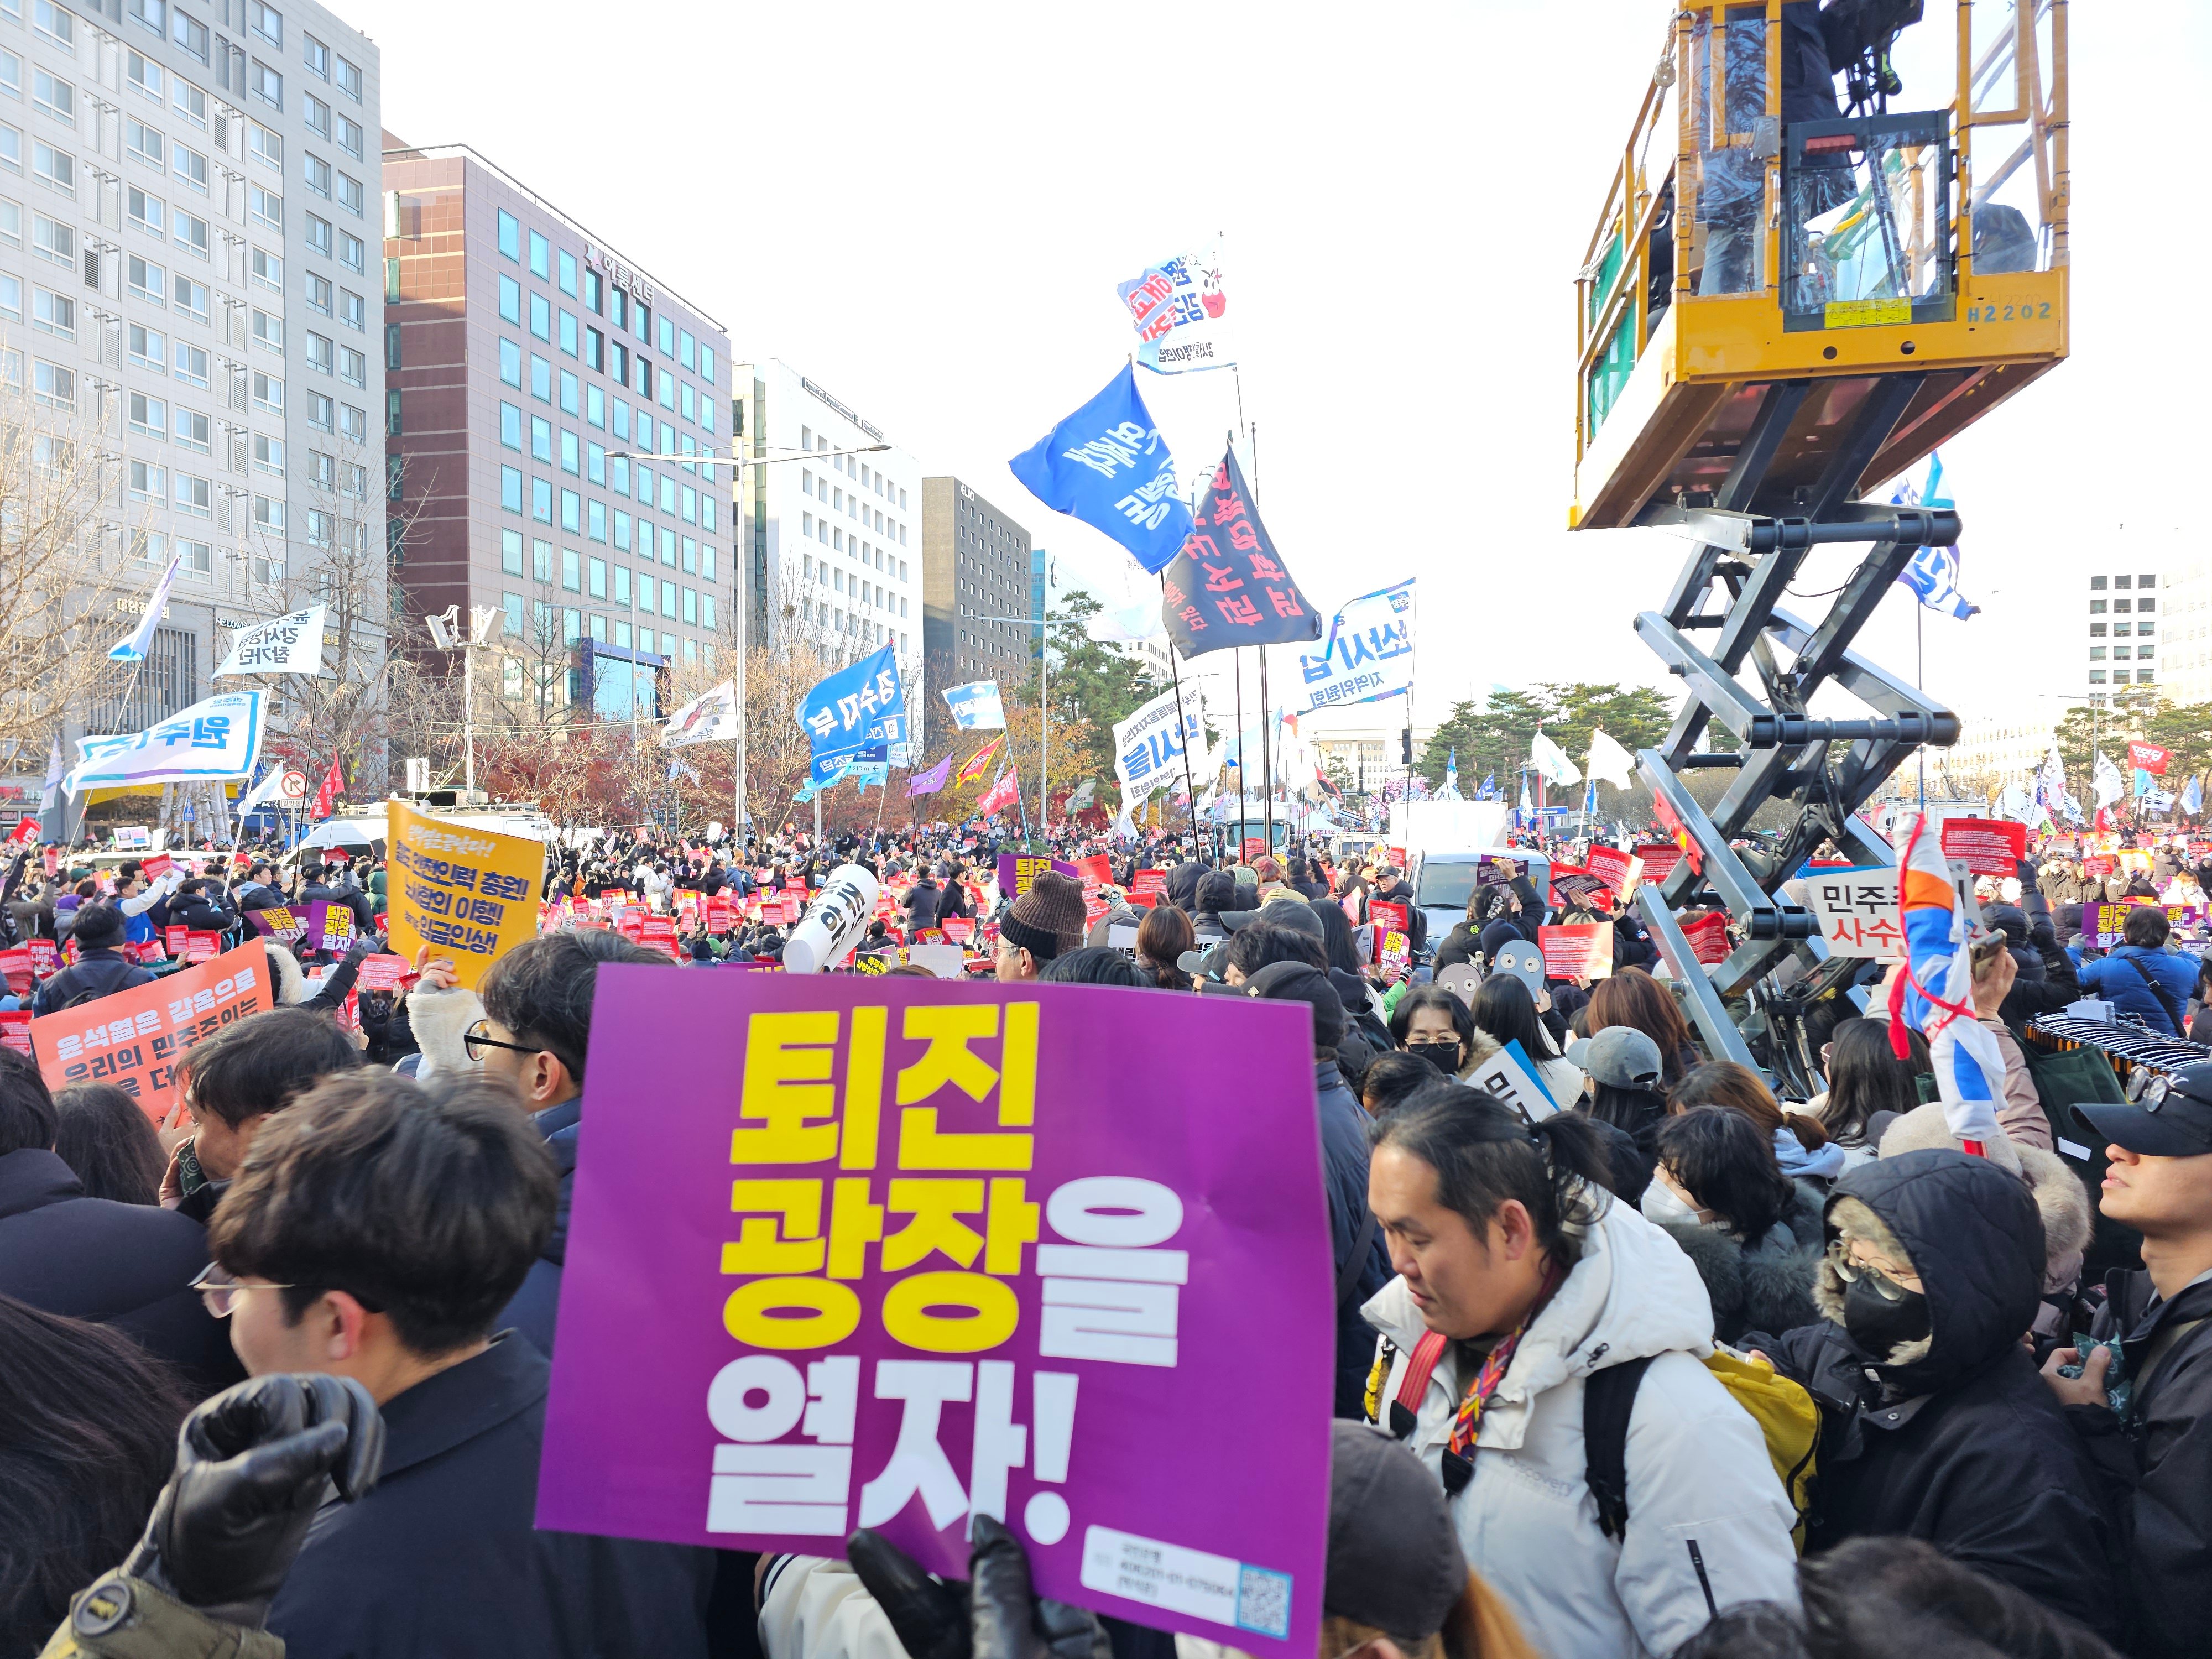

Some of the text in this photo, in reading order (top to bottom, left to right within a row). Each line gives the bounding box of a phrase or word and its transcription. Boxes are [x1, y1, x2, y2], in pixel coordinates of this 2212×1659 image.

[603, 256, 654, 307] 이룸센터
[1968, 303, 2051, 322] H2202
[961, 484, 975, 502] GLAD
[1178, 606, 1208, 631] 있다
[480, 870, 530, 902] 충원!
[260, 907, 292, 920] 퇴진
[267, 916, 309, 930] 광장을
[326, 905, 350, 923] 퇴진
[456, 896, 505, 926] 이행!
[2098, 905, 2131, 919] 퇴진
[324, 919, 356, 940] 광장을
[1831, 917, 1902, 948] 사수
[322, 935, 351, 952] 열자!
[56, 967, 257, 1061] 윤석열은 감옥으로
[729, 1001, 1040, 1171] 퇴진
[720, 1175, 1189, 1368] 광장을
[705, 1354, 1080, 1546] 열자!
